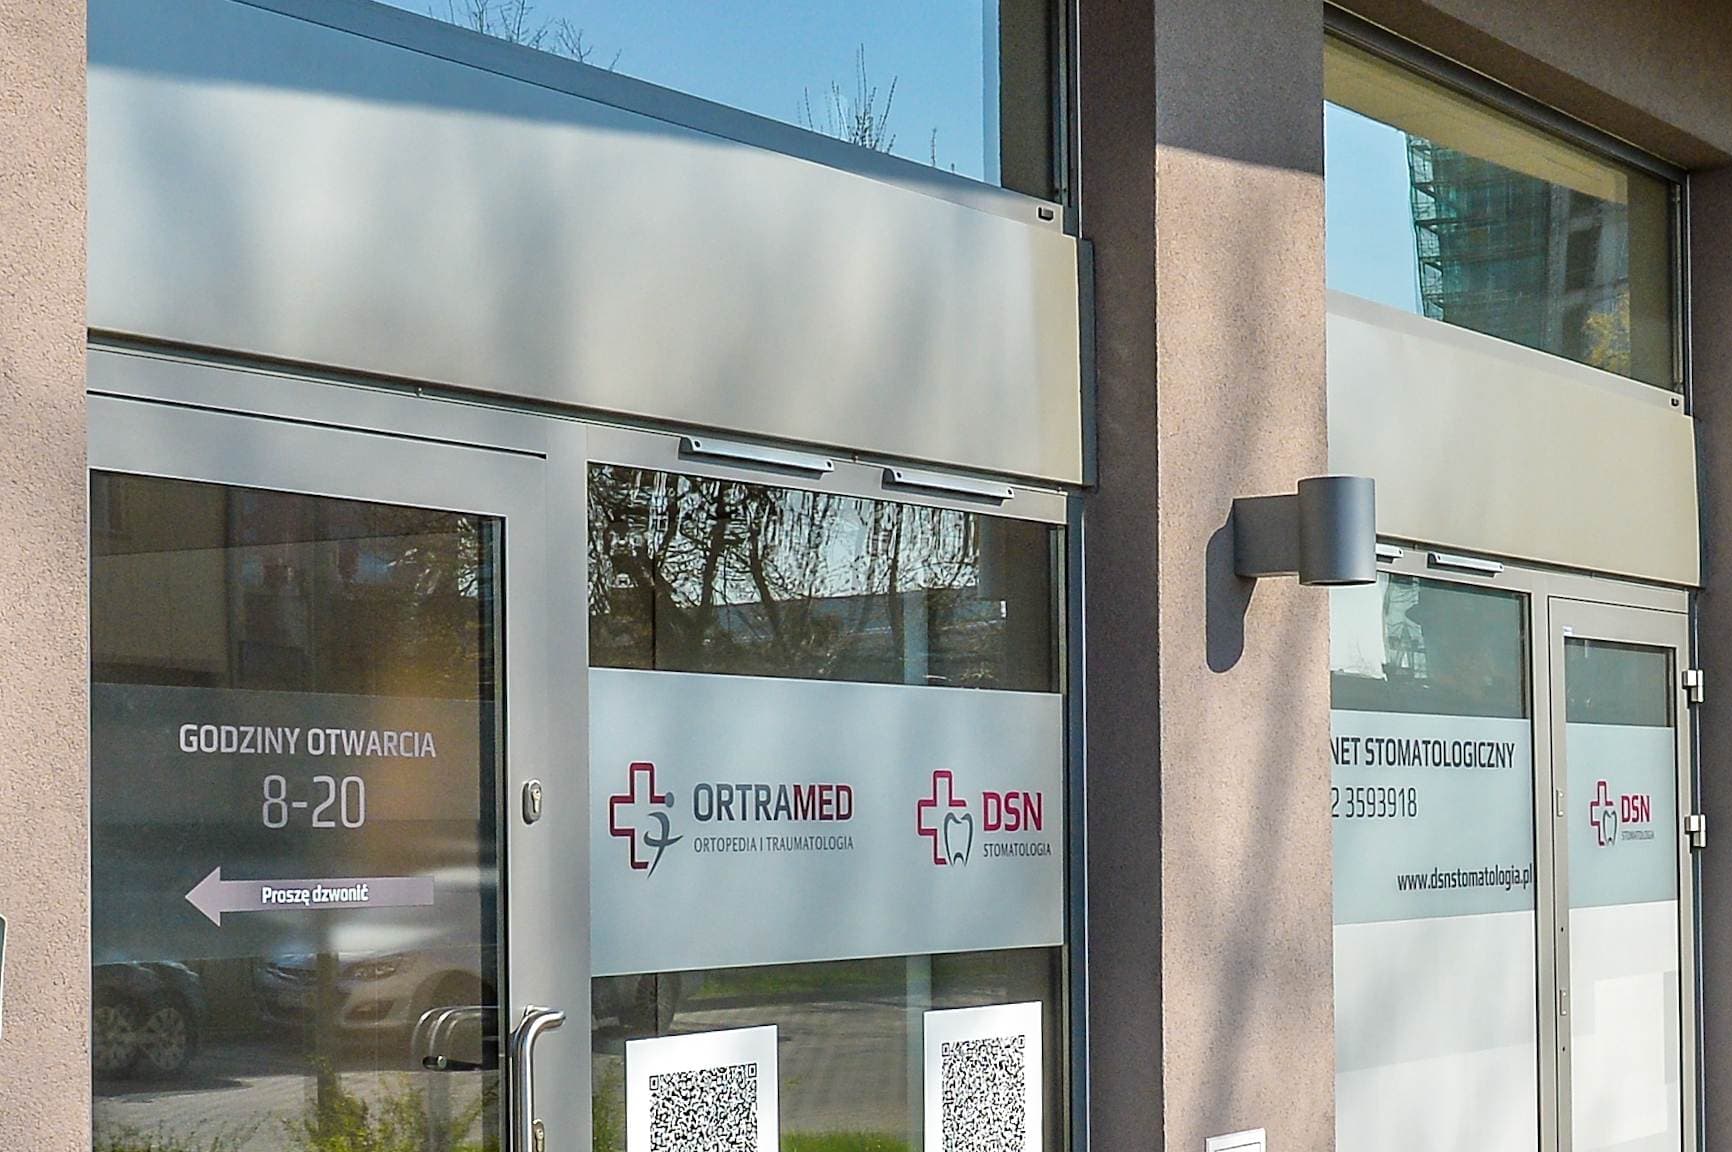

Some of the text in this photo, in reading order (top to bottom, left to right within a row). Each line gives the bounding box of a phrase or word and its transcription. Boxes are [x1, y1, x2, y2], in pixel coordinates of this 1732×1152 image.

[179, 724, 437, 758] GODZINY OTWARCIA
[1365, 738, 1516, 769] STOMATOLOGICZNY
[262, 774, 366, 829] 8-20
[693, 783, 854, 822] ORTRAMED
[983, 791, 1043, 832] DSN
[1345, 787, 1418, 818] 3593918
[1621, 794, 1650, 823] DSN
[694, 836, 758, 853] ORTOPEDIA
[766, 835, 854, 852] TRAUMATOLOGIA
[983, 842, 1052, 858] STOMATOLOGIA
[1398, 863, 1533, 892] www.dsnstomatologia.pl
[262, 883, 369, 906] Proszę dzwonić
